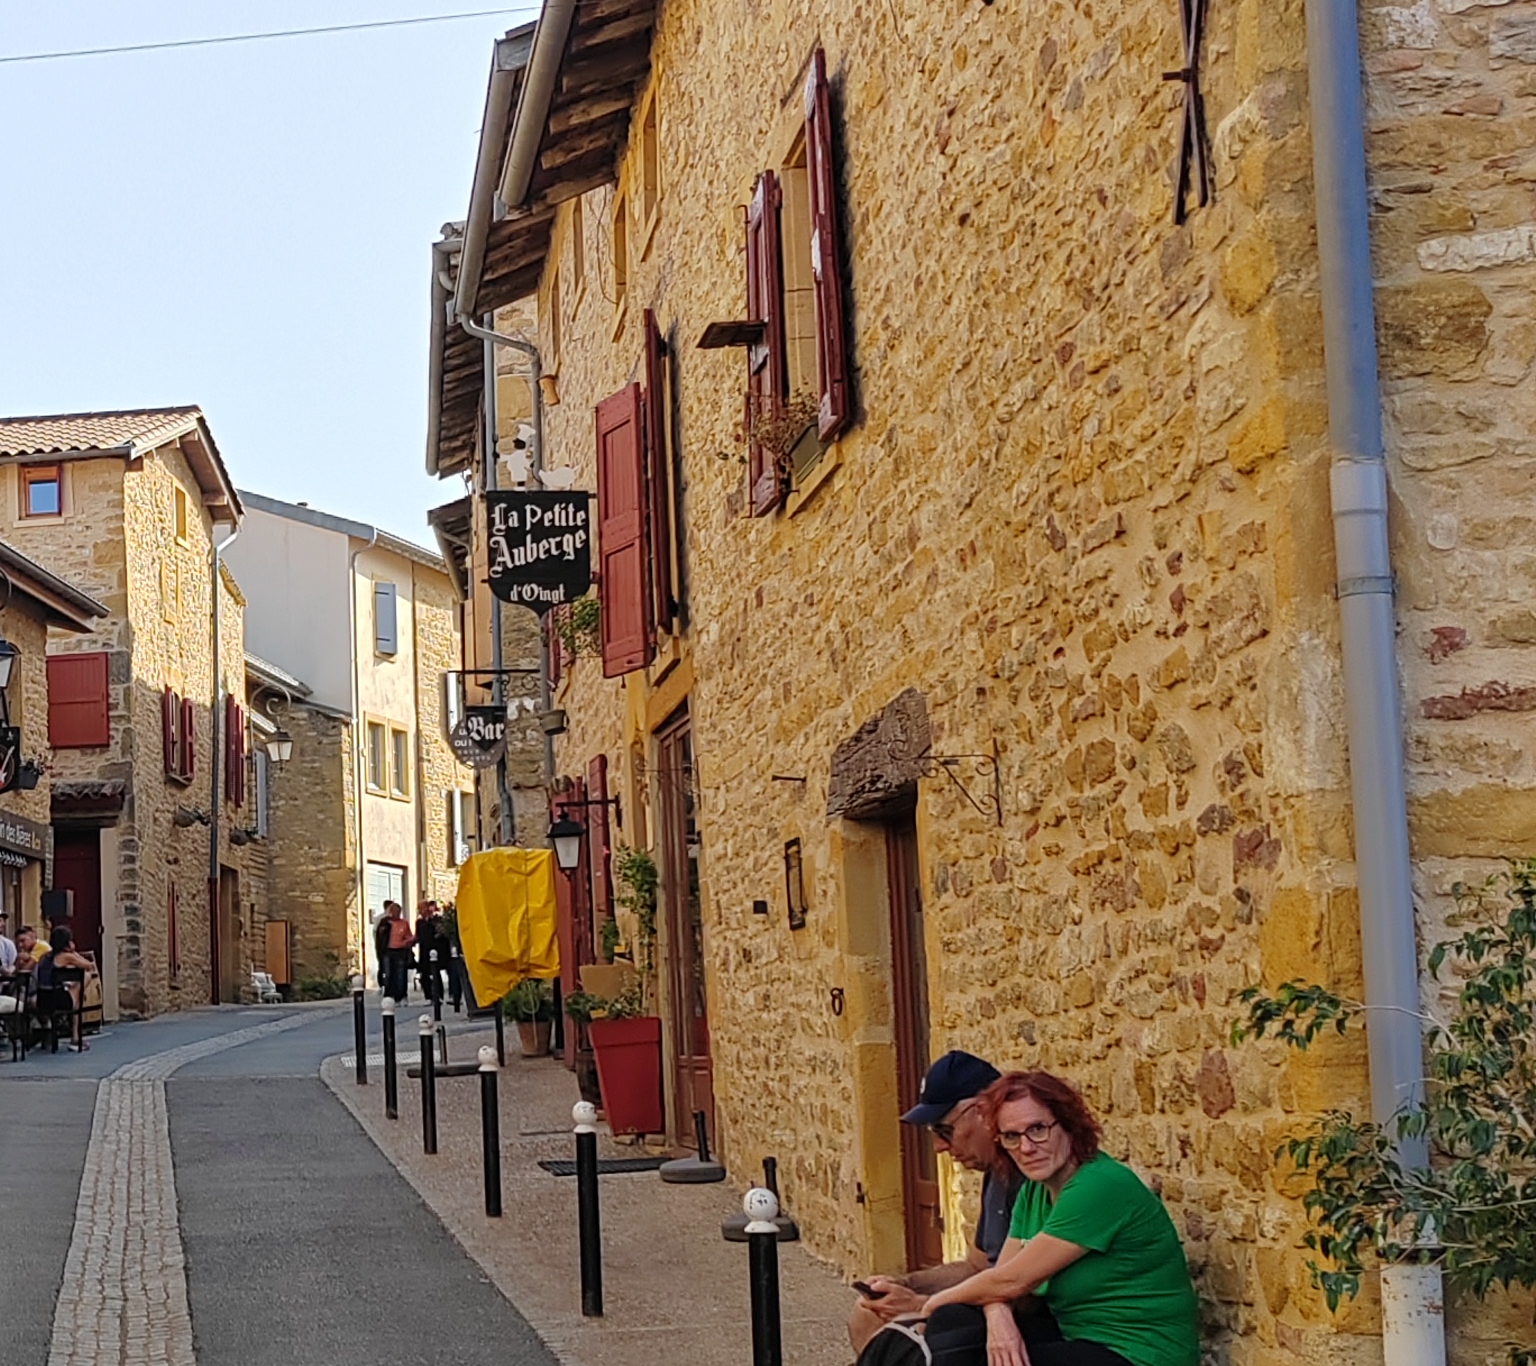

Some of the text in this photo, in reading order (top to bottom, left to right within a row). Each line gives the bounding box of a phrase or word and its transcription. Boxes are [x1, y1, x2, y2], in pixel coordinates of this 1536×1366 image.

[491, 502, 586, 535] La Petite
[489, 529, 587, 578] Auberge
[510, 583, 566, 604] d'Oingt
[467, 716, 504, 741] Bar
[6, 821, 16, 843] des
